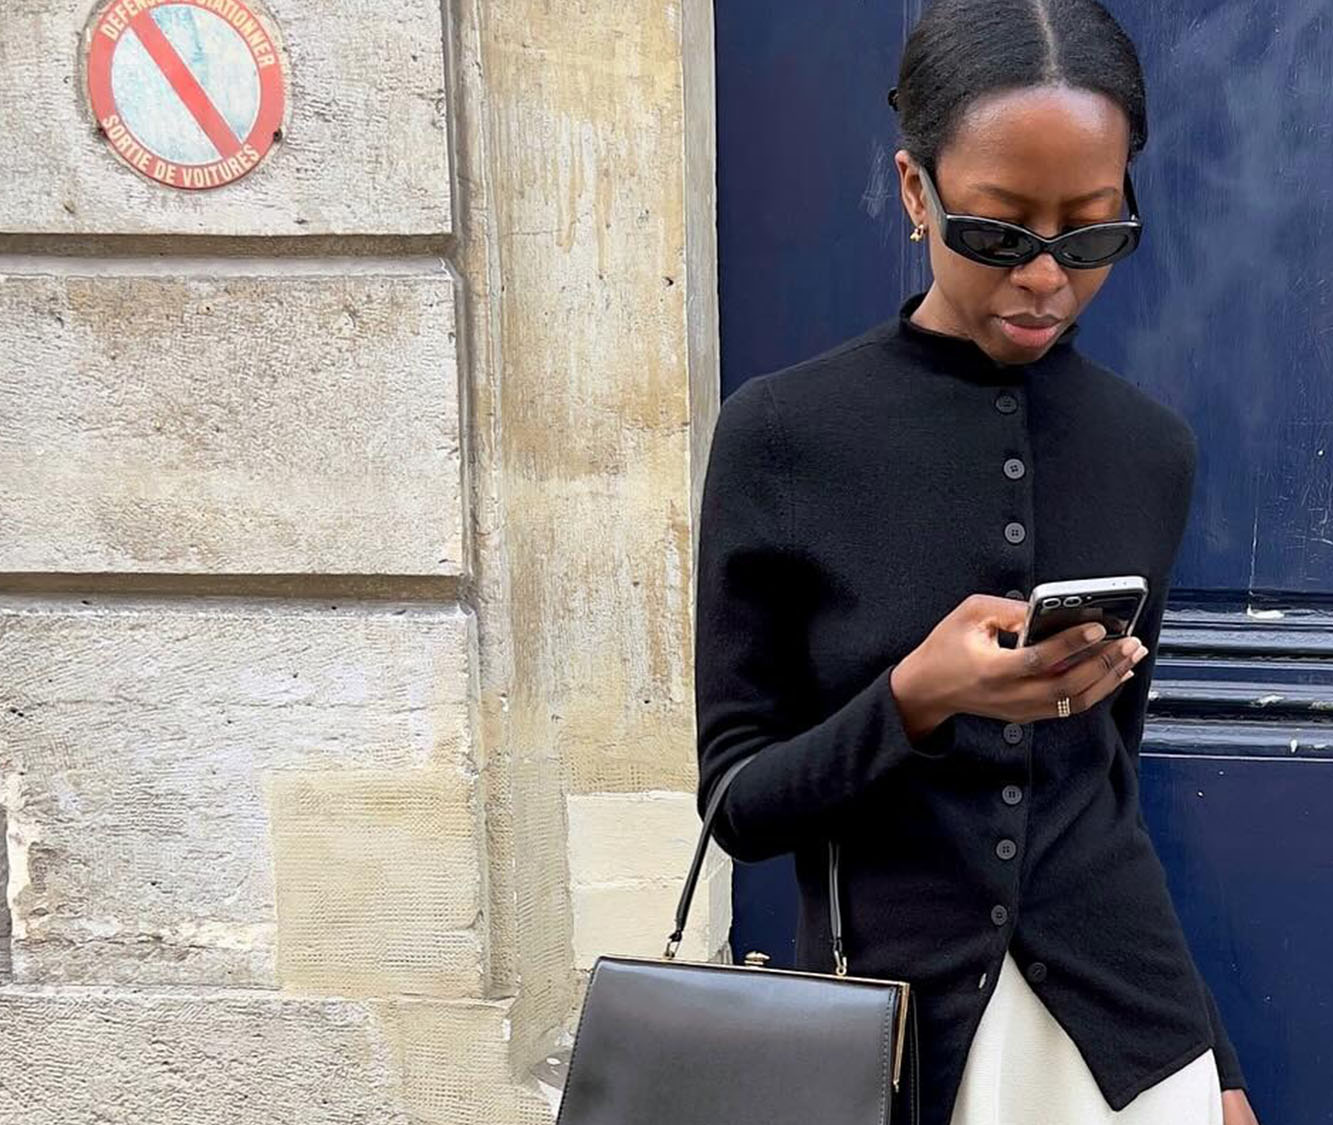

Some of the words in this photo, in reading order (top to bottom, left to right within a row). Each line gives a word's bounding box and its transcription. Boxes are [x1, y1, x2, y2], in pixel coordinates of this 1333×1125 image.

[101, 0, 163, 40] DEFEN
[196, 0, 275, 67] ATIONNER
[102, 114, 153, 171] SORTIE
[154, 160, 177, 183] DE
[182, 144, 260, 187] VOITURES
